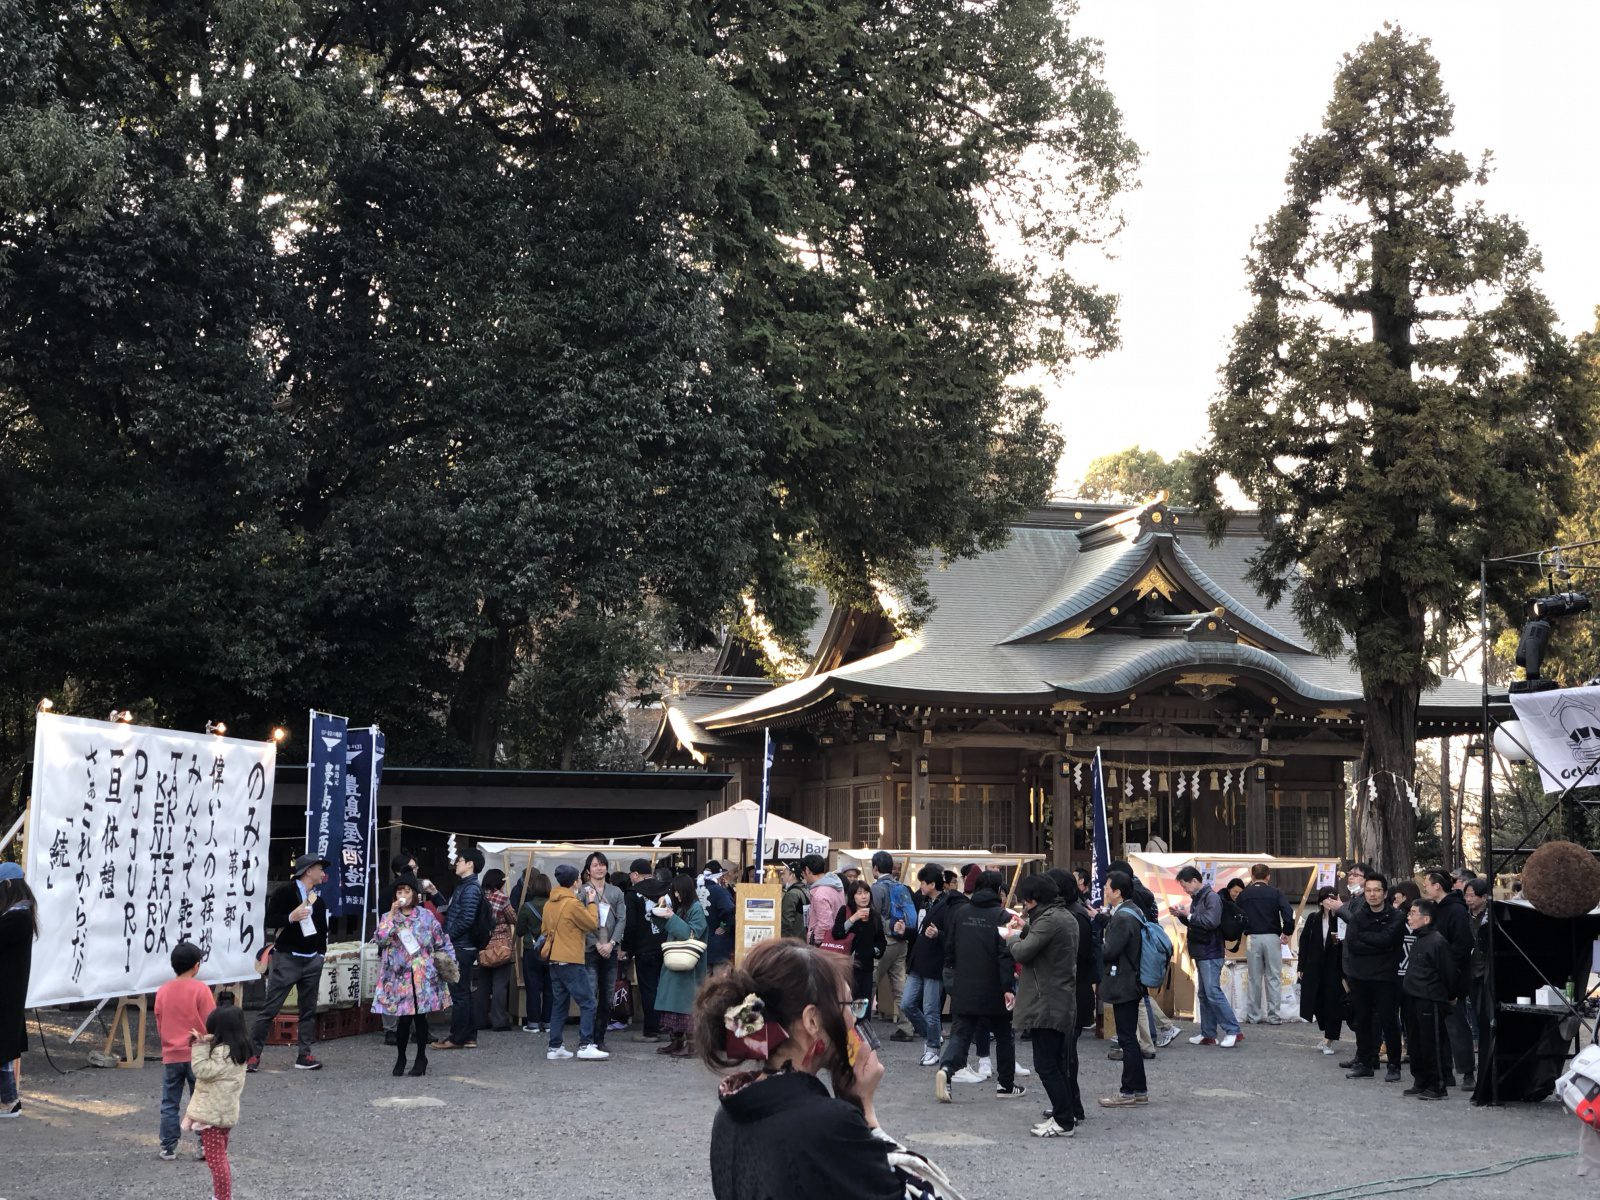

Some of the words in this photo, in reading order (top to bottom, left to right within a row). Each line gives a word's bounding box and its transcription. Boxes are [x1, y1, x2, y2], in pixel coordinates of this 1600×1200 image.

[99, 749, 124, 900] 一旦休憩
[131, 749, 149, 819] DJ
[157, 751, 183, 954] TAKIZAWA
[239, 761, 266, 954] のみむら
[805, 843, 827, 855] Bar
[123, 828, 139, 974] JURI
[144, 770, 168, 954] KENTARO
